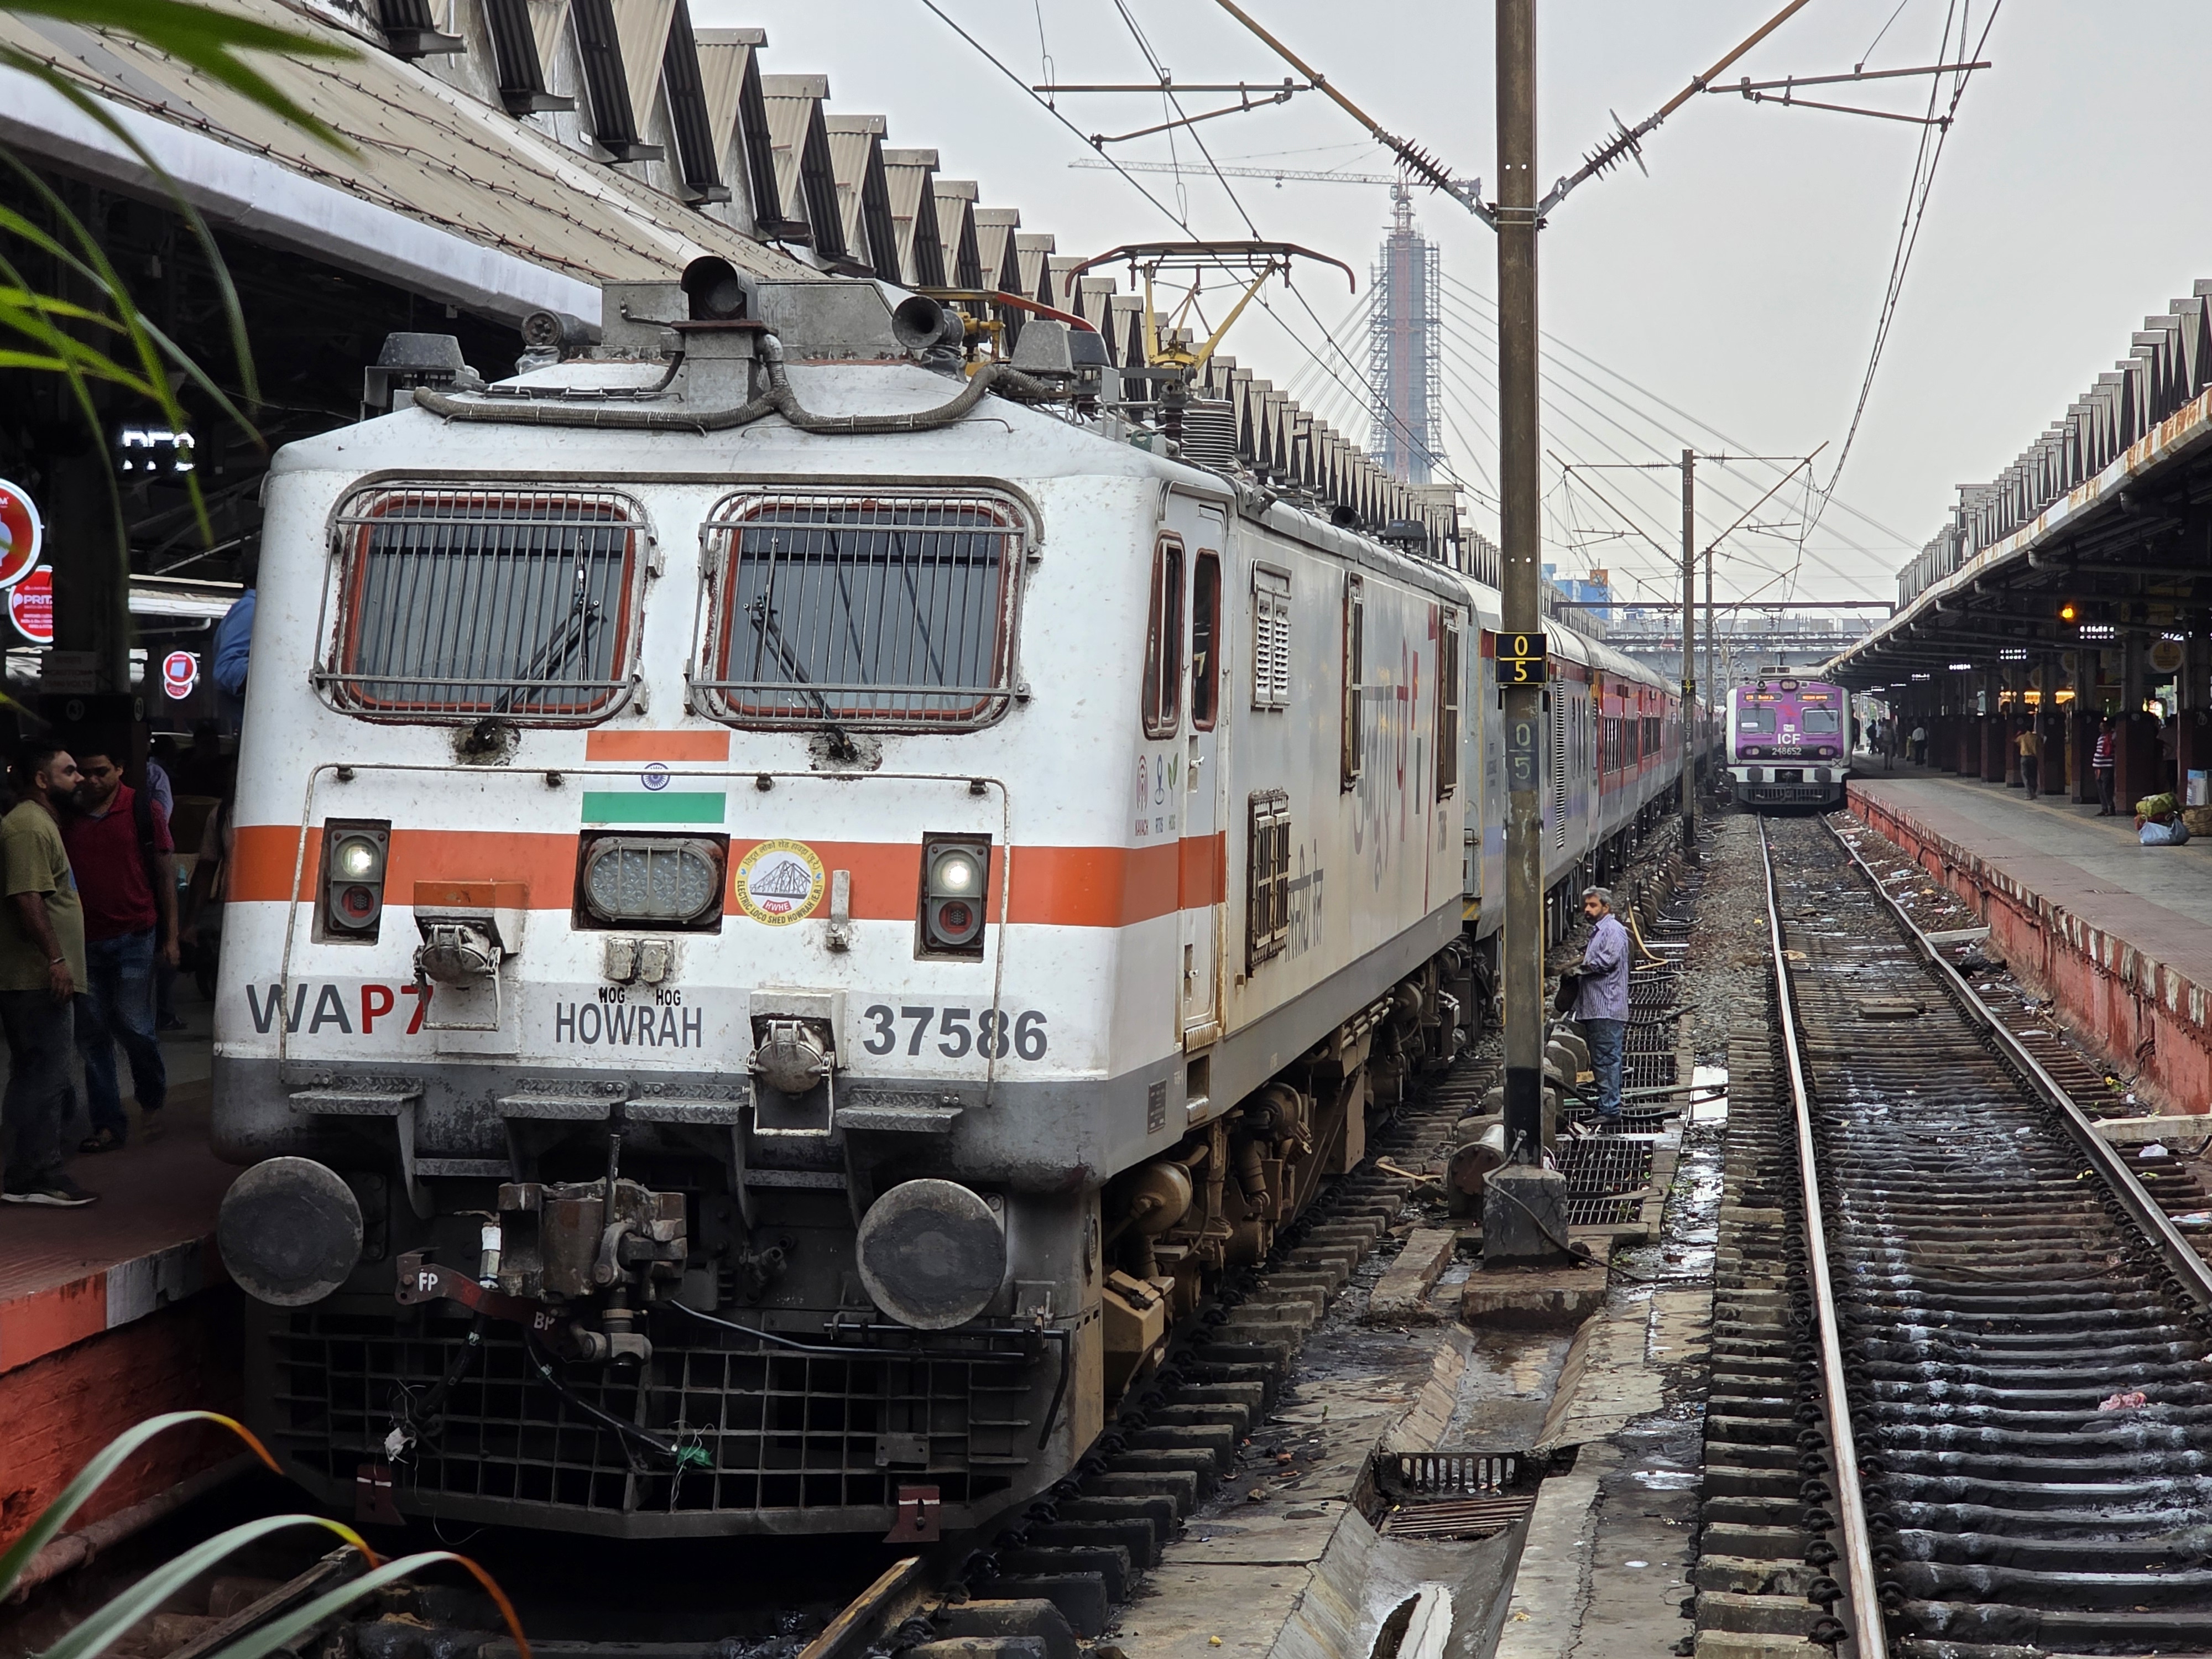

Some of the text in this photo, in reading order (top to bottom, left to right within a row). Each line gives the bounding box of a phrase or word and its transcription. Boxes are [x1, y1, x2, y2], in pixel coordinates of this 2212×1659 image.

[24, 594, 53, 605] PRIT
[1514, 635, 1528, 656] 0
[1514, 661, 1527, 681] 5
[1516, 723, 1531, 747] 0
[1777, 733, 1801, 744] ICF
[1772, 748, 1802, 756] 248652
[1515, 757, 1531, 780] 5
[737, 880, 753, 910] ELECTRIC
[750, 907, 767, 922] LOCO
[768, 916, 786, 924] SHED
[787, 901, 815, 922] HOWRAH
[765, 902, 790, 911] HWHE
[656, 989, 681, 1006] HOG
[556, 1002, 702, 1048] HOWRAH
[863, 1004, 1048, 1061] 37586
[419, 1272, 439, 1292] FP
